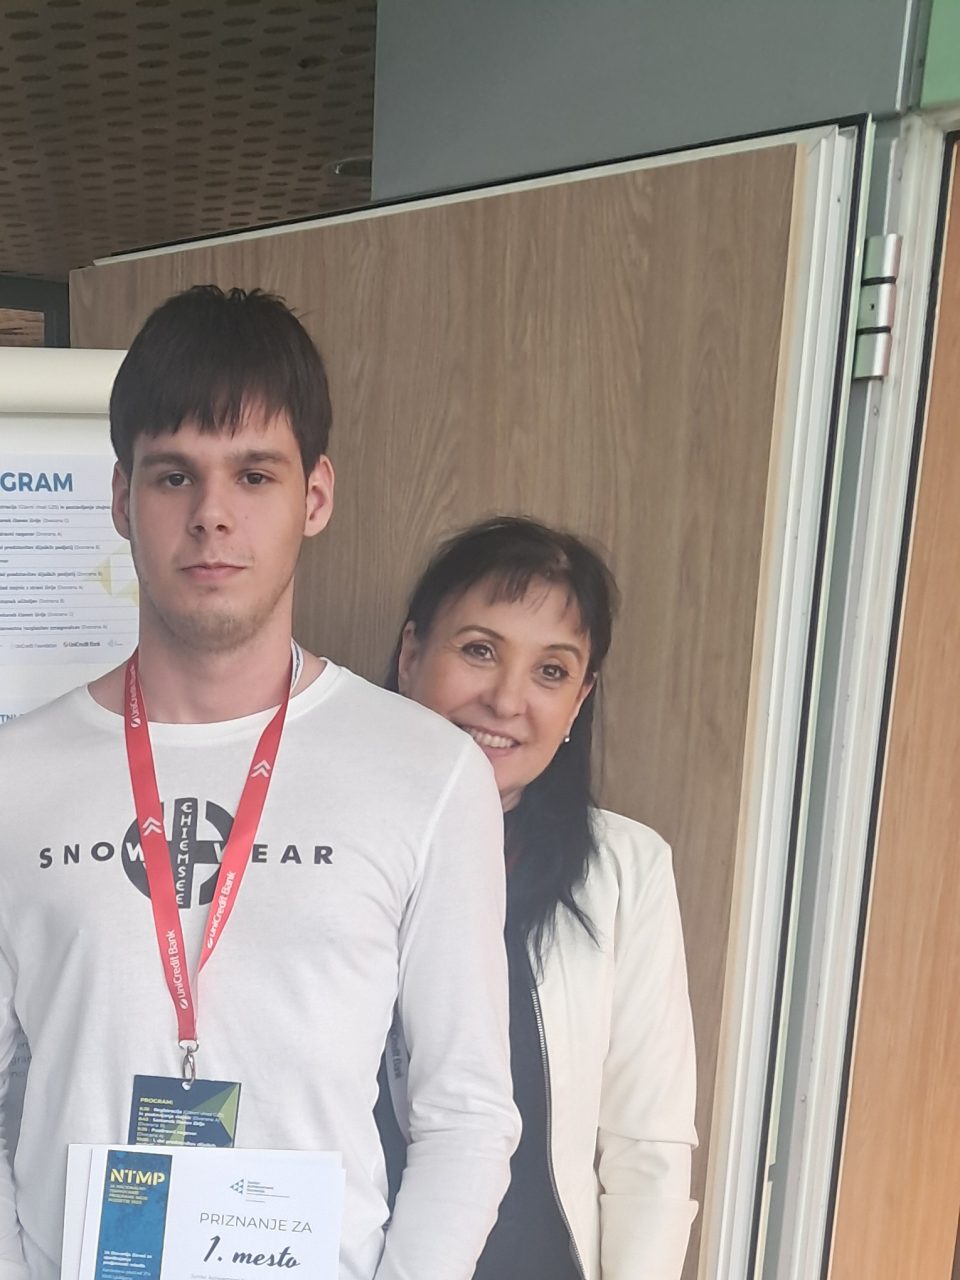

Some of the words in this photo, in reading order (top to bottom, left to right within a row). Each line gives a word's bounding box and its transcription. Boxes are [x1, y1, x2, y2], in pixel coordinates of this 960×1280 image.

[175, 801, 193, 905] CHIEMSEE
[209, 895, 228, 937] UniCredit
[221, 870, 236, 895] Bank
[165, 929, 179, 955] Bank
[167, 954, 185, 999] UniCredit
[110, 1168, 166, 1186] NTMP
[200, 1212, 288, 1232] PRIZNANJE
[291, 1220, 313, 1234] ZA
[203, 1235, 223, 1263] 1.
[231, 1246, 301, 1269] mesto
